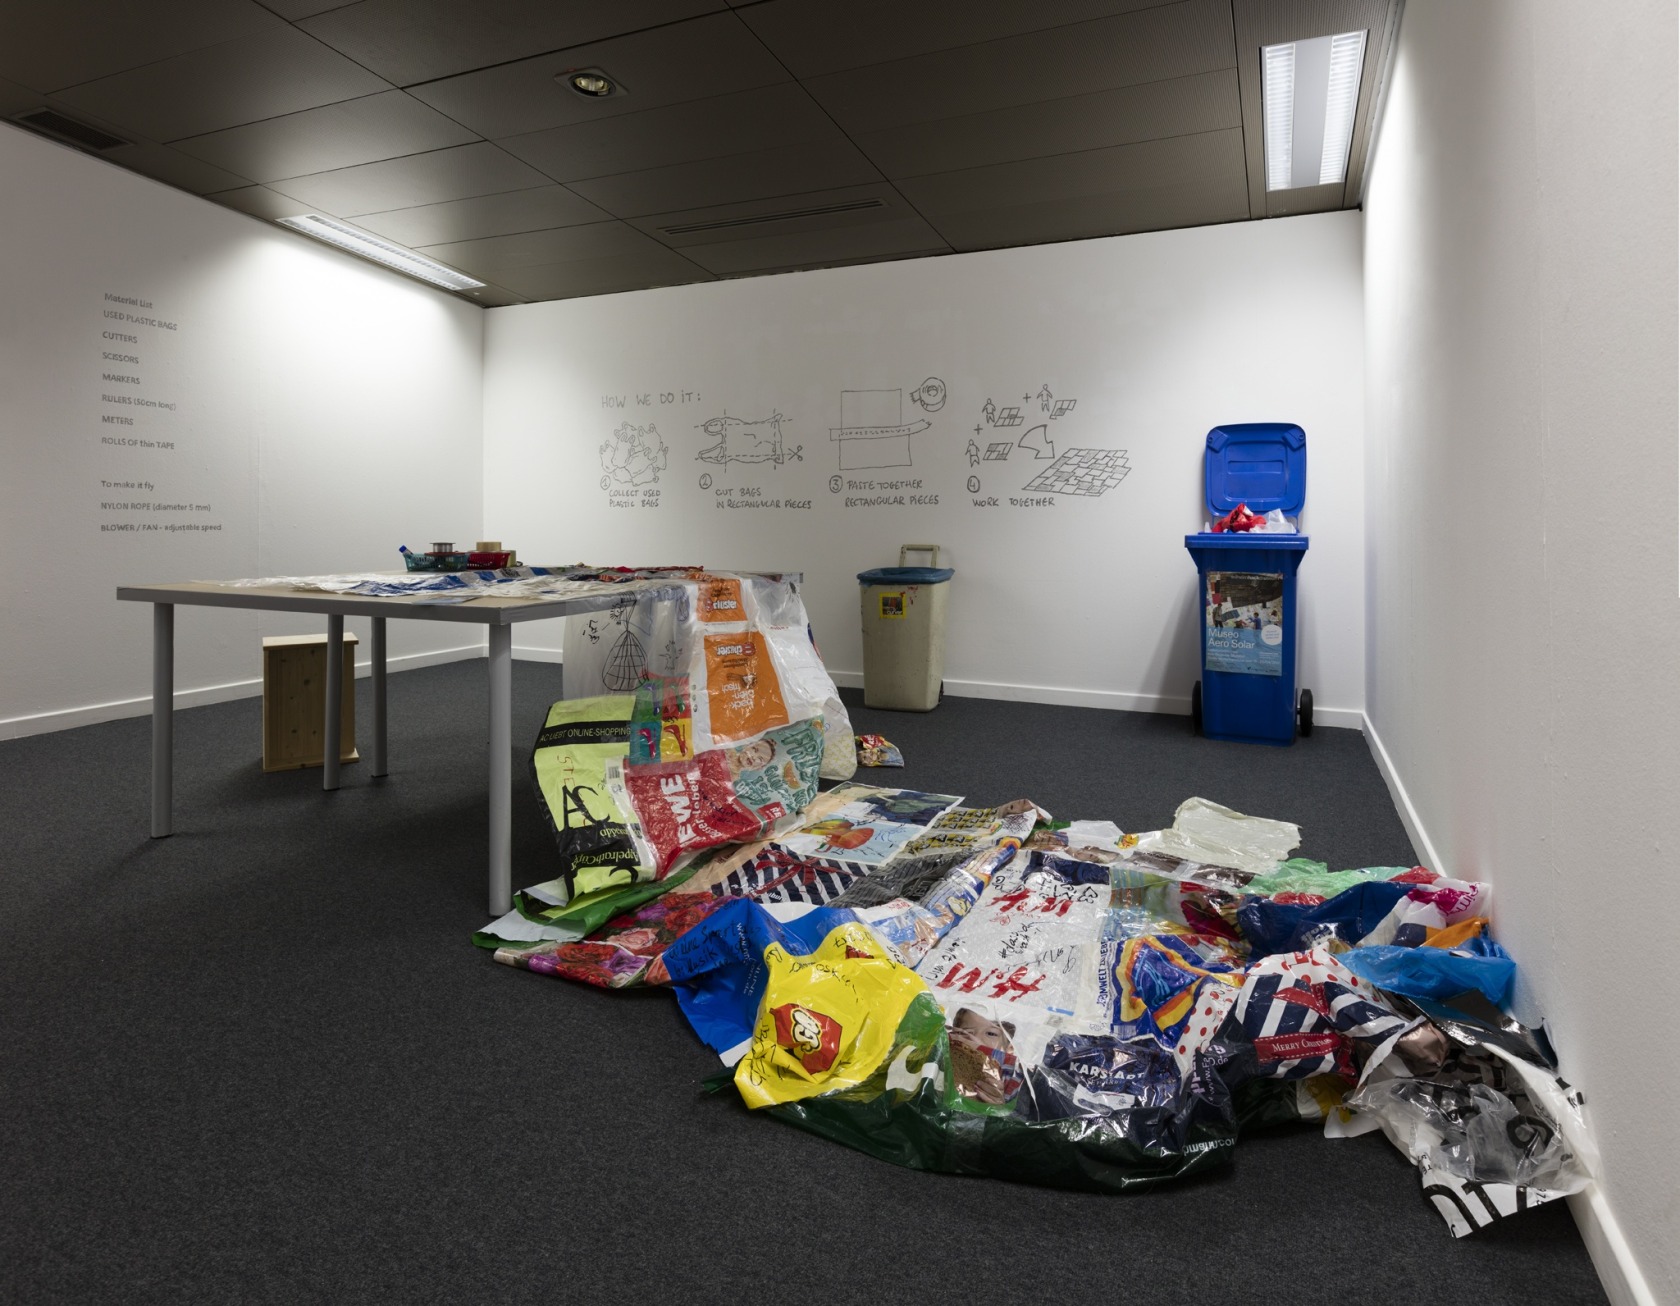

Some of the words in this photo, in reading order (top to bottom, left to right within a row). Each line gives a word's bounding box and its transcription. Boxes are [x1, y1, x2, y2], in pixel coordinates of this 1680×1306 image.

[104, 293, 138, 306] Material
[140, 300, 153, 309] List
[103, 310, 125, 321] USED
[126, 314, 157, 327] PLASTIC
[158, 320, 178, 331] BAGS
[102, 331, 138, 344] CUTTERS
[102, 352, 139, 364] SCISSORS
[102, 373, 141, 385] MARKERS
[102, 394, 132, 405] RULERS
[134, 397, 157, 408] (50cm
[158, 400, 177, 411] long)
[601, 395, 626, 409] HOW
[636, 393, 652, 407] WE
[659, 392, 675, 404] DO
[102, 415, 134, 426] METERS
[101, 437, 126, 446] ROLLS
[140, 440, 155, 448] thin
[156, 441, 175, 450] TAPE
[101, 480, 112, 488] To
[113, 481, 135, 489] make
[138, 481, 143, 489] it
[144, 481, 155, 492] fly
[846, 480, 875, 490] PASTE
[876, 479, 923, 490] TOGETHER
[608, 488, 639, 498] COLLECT
[642, 488, 661, 497] USED
[716, 488, 730, 497] CUT
[739, 487, 762, 497] BAGS
[101, 502, 129, 510] NYLON
[131, 503, 150, 511] ROPE
[152, 503, 187, 512] (diameter
[195, 504, 211, 512] mm)
[641, 498, 659, 508] BAGS
[726, 499, 781, 509] RECTANGULAR
[845, 495, 905, 508] RECTANGULAR
[972, 498, 999, 507] WORK
[1009, 497, 1055, 507] TOGETHER
[101, 524, 135, 532] BLOWER
[164, 524, 200, 533] adjustable
[201, 525, 221, 533] speed
[1208, 628, 1239, 639] Museo
[1208, 638, 1230, 648] Aero
[1231, 639, 1255, 649] Solar
[539, 733, 550, 742] AC
[550, 730, 567, 740] LIEBT
[567, 727, 631, 738] ONLINE-SHOPPING
[1272, 1040, 1301, 1054] MERRY
